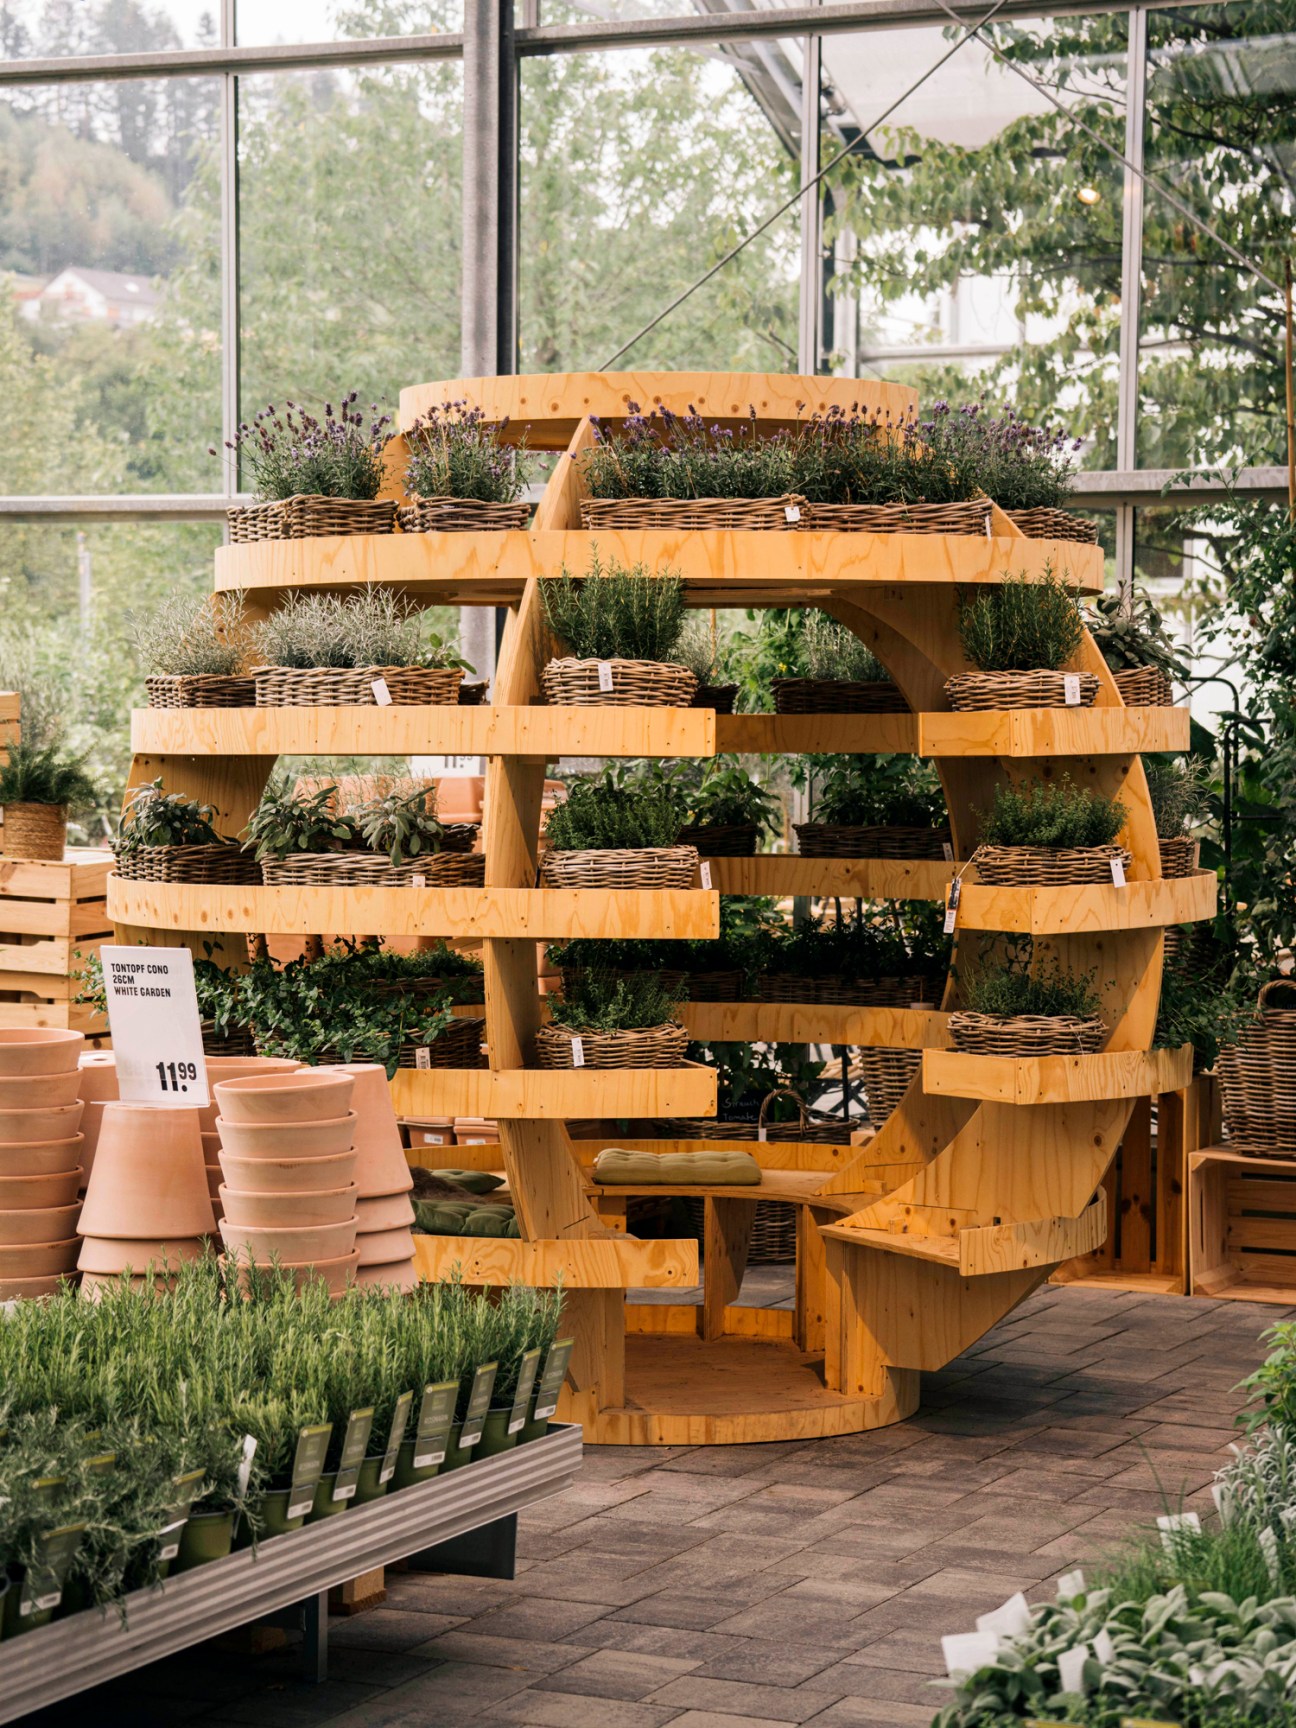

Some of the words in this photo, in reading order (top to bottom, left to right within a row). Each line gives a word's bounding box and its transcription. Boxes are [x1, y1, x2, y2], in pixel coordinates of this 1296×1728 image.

[111, 963, 145, 973] TONTOPF
[147, 964, 169, 975] CONO
[112, 974, 135, 984] 26CM
[113, 986, 139, 996] WHITE
[140, 987, 171, 998] GARDEN
[156, 1061, 197, 1092] 11.99
